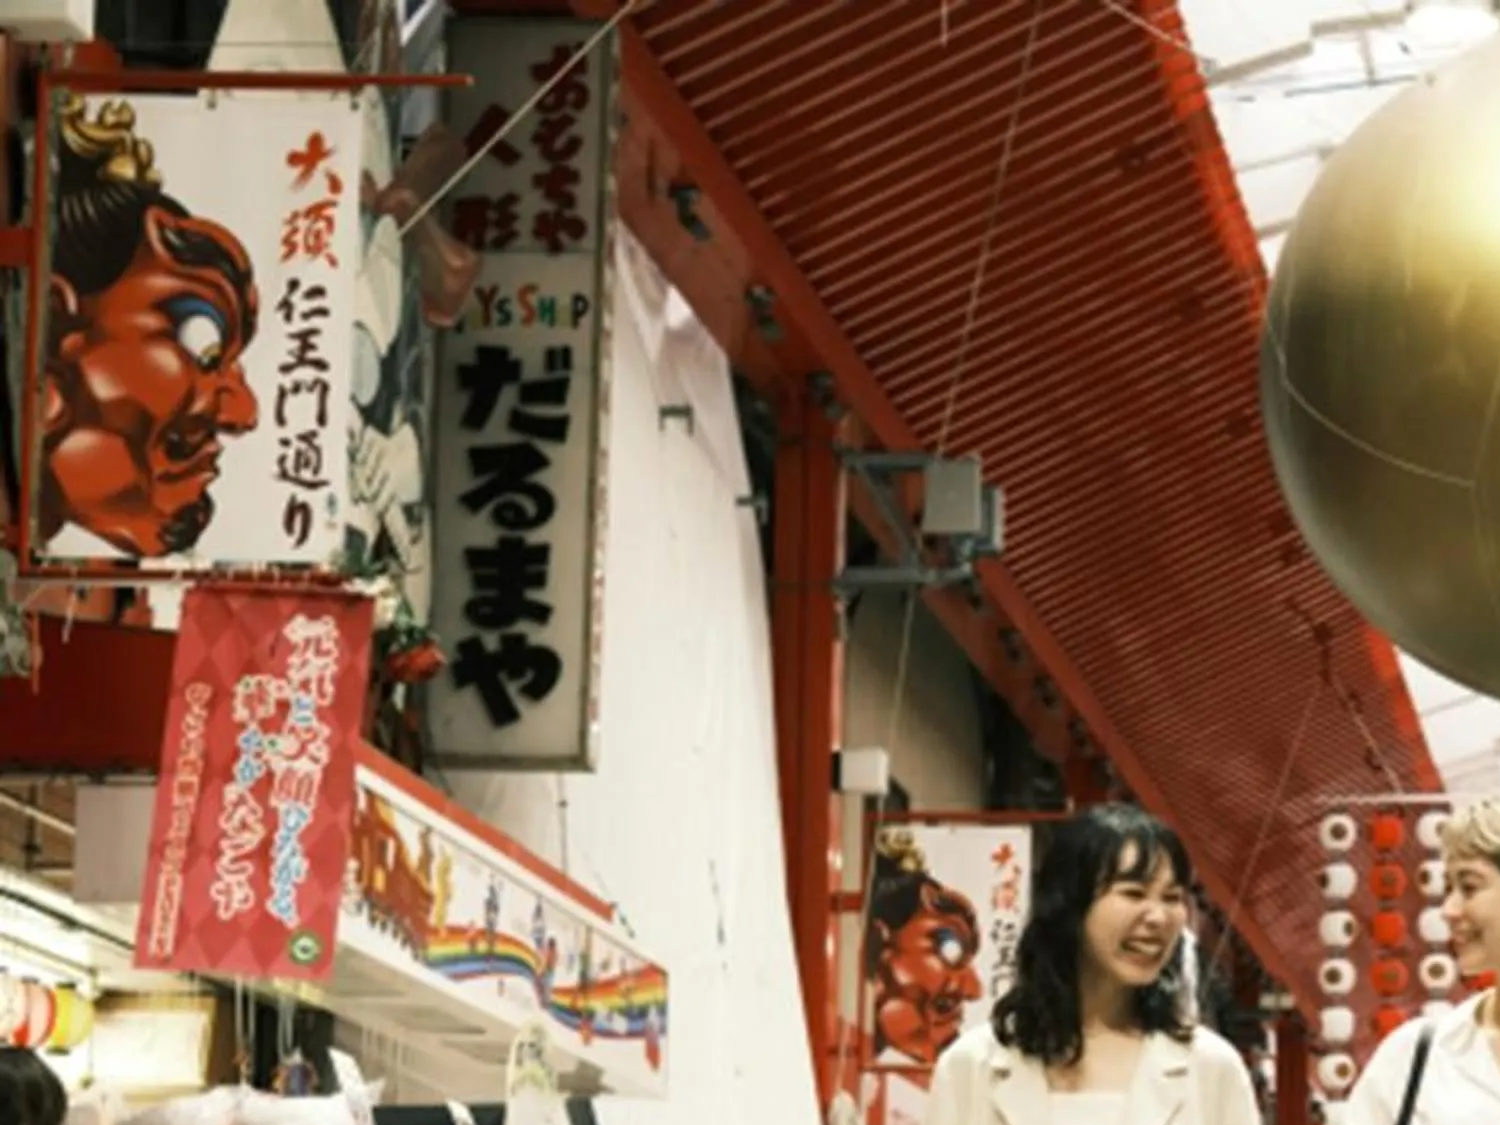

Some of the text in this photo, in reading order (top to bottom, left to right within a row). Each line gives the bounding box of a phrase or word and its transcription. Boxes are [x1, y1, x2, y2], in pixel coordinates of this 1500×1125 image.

[274, 131, 343, 550] 大須仁王門通り
[451, 344, 572, 728] だるまや
